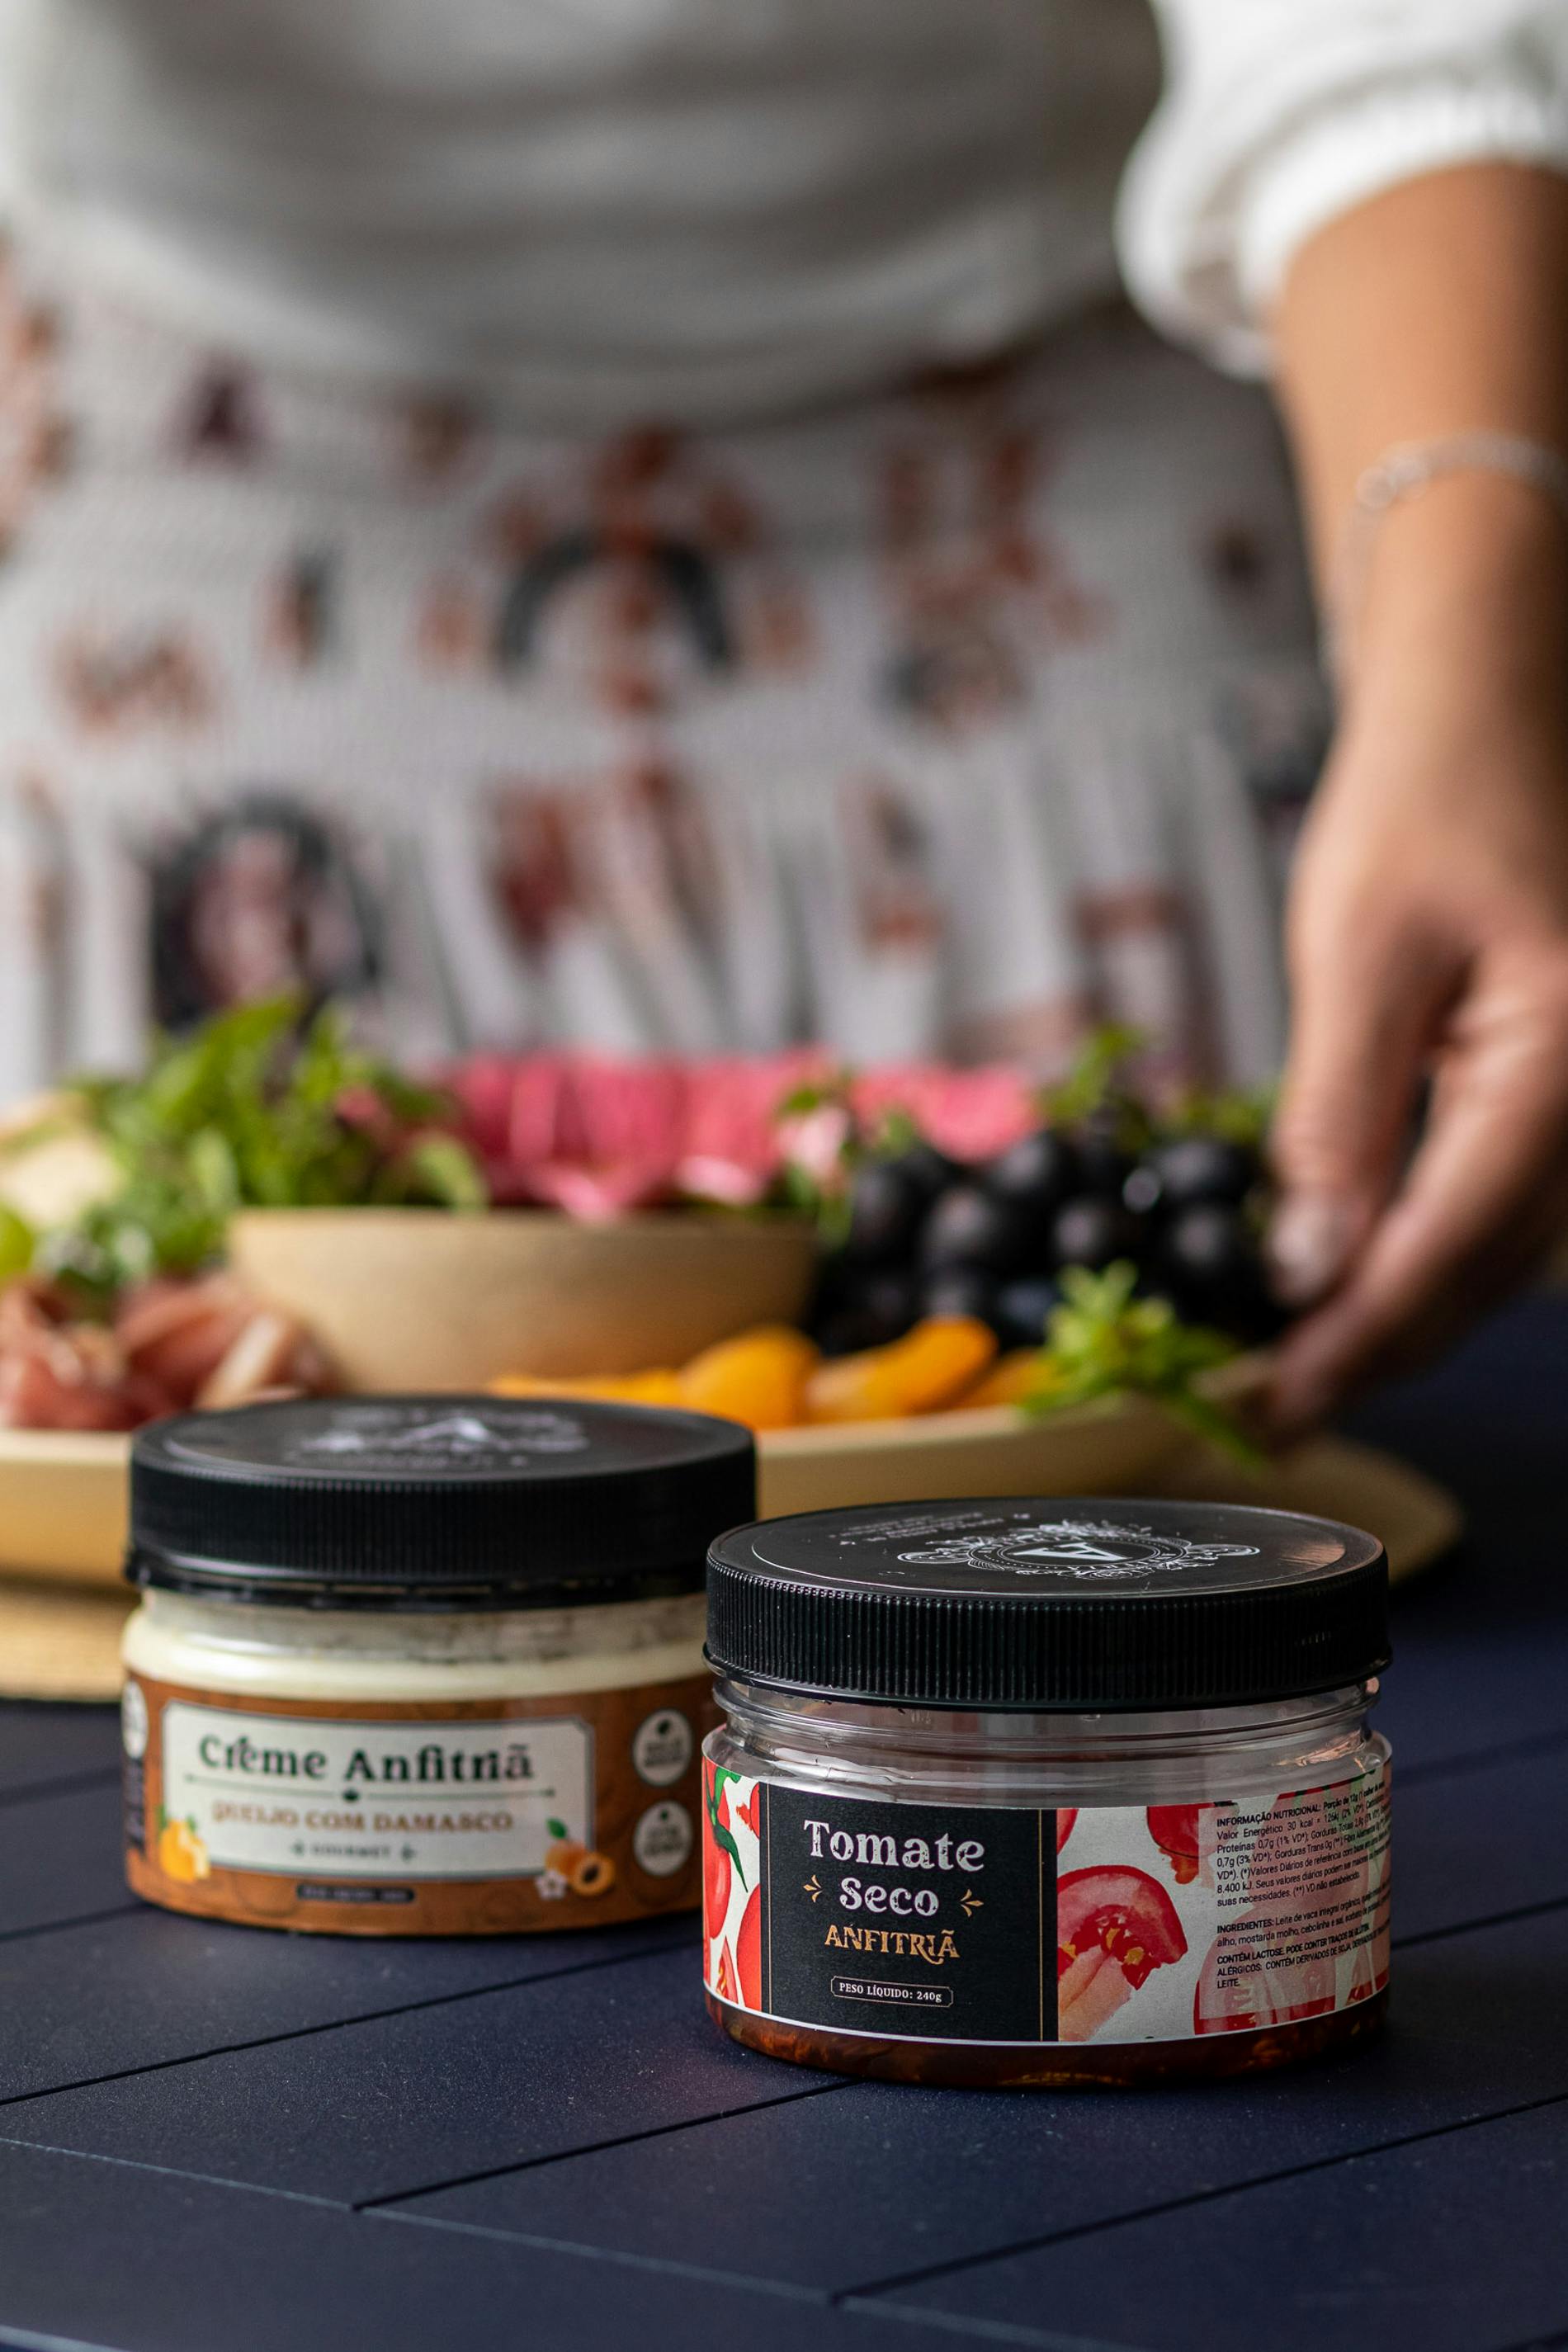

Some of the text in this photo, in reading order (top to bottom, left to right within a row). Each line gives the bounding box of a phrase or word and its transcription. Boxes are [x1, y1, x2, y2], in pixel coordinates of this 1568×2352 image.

[344, 1743, 534, 1783] Anfitriã
[305, 1811, 365, 1831] COM
[374, 1811, 513, 1833] DAMASCO
[1217, 1812, 1271, 1826] INFORMAÇÃO
[1273, 1805, 1320, 1819] NUTRICIONAL:
[1217, 1830, 1238, 1840] Valor
[1243, 1825, 1283, 1838] Energético
[1287, 1821, 1296, 1830] 30
[1300, 1818, 1314, 1828] kcal
[804, 1820, 985, 1872] Tomate
[1217, 1842, 1255, 1854] Proteínas
[1258, 1839, 1274, 1849] 0,7g
[1277, 1836, 1289, 1847] (1%
[1311, 1827, 1337, 1840] Gorduras
[1217, 1857, 1235, 1868] 0,7g
[1236, 1854, 1251, 1867] (3%
[1275, 1847, 1306, 1859] Gorduras
[1307, 1844, 1324, 1853] Trans
[1325, 1840, 1332, 1849] 0g
[1280, 1862, 1304, 1872] Diários
[1305, 1858, 1313, 1867] de
[1314, 1852, 1341, 1864] referência
[1343, 1849, 1353, 1857] com
[1217, 1882, 1240, 1894] 8.400
[1255, 1879, 1274, 1889] Seus
[1276, 1874, 1301, 1885] valores
[1301, 1870, 1322, 1882] diários
[1324, 1864, 1343, 1877] podem
[839, 1877, 939, 1916] Seco
[1217, 1897, 1237, 1907] suas
[1239, 1890, 1291, 1904] necessidades.
[1306, 1882, 1315, 1892] VD
[1316, 1881, 1328, 1890] não
[1217, 1918, 1273, 1934] INGREDIENTES:
[1275, 1916, 1292, 1925] Leite
[1294, 1913, 1302, 1922] de
[1304, 1910, 1318, 1920] vaca
[1319, 1905, 1339, 1916] integral
[824, 1923, 961, 1965] ANFITRIÃ
[1217, 1937, 1237, 1947] alho,
[1239, 1932, 1275, 1944] mostarda
[1276, 1927, 1299, 1939] molho,
[1301, 1920, 1329, 1934] cebolinha
[1217, 1952, 1250, 1964] CONTÉM
[1286, 1943, 1303, 1953] PODE
[1305, 1937, 1327, 1950] CONTER
[1217, 1963, 1262, 1977] ALÉRGICOS:
[1265, 1958, 1295, 1970] CONTÉM
[1296, 1950, 1329, 1964] DERIVADOS
[1330, 1948, 1337, 1956] DE
[839, 1982, 942, 2003] PESO LÍQUIDO: 240g
[1217, 1978, 1240, 1989] LEITE.
